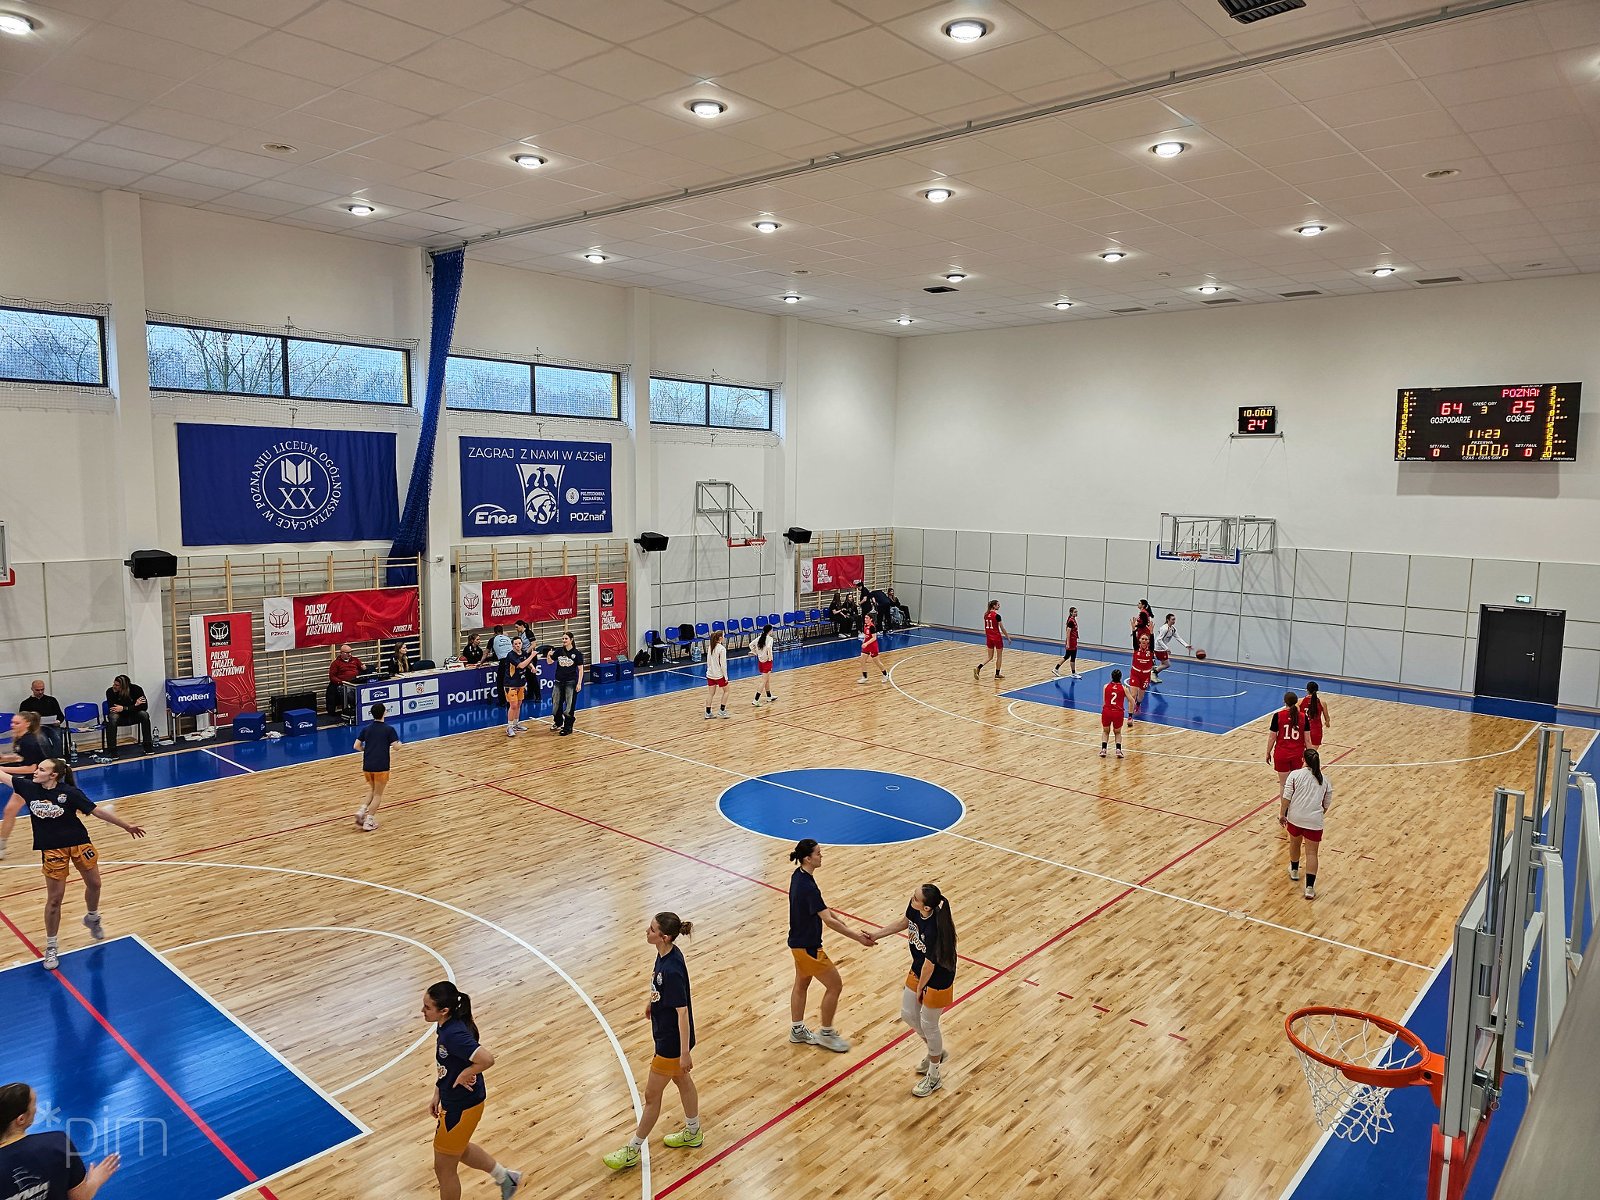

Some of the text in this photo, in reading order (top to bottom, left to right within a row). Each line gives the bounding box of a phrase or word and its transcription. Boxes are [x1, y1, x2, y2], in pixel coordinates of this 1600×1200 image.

[1441, 402, 1463, 416] 64
[1480, 405, 1488, 415] 3
[1512, 400, 1535, 414] 25
[1430, 416, 1472, 424] GOSPODARZE
[1505, 414, 1532, 423] GOŚCIE
[1469, 429, 1501, 439] 11:23
[468, 447, 606, 462] ZAGRAJ Z NAMI W AZSie!
[1432, 448, 1440, 457] 0
[1524, 447, 1533, 457] 0
[250, 440, 341, 531] LICEUM OGÓLNOKSZTAŁCĄCE W POZNANIU
[278, 487, 316, 510] XX
[475, 511, 518, 525] Enea
[304, 603, 328, 616] POLSKI
[985, 619, 994, 630] 11
[210, 650, 230, 661] POLSKI
[178, 692, 210, 703] molten
[1110, 692, 1118, 705] 2
[1283, 724, 1300, 741] 16
[82, 848, 95, 861] 16
